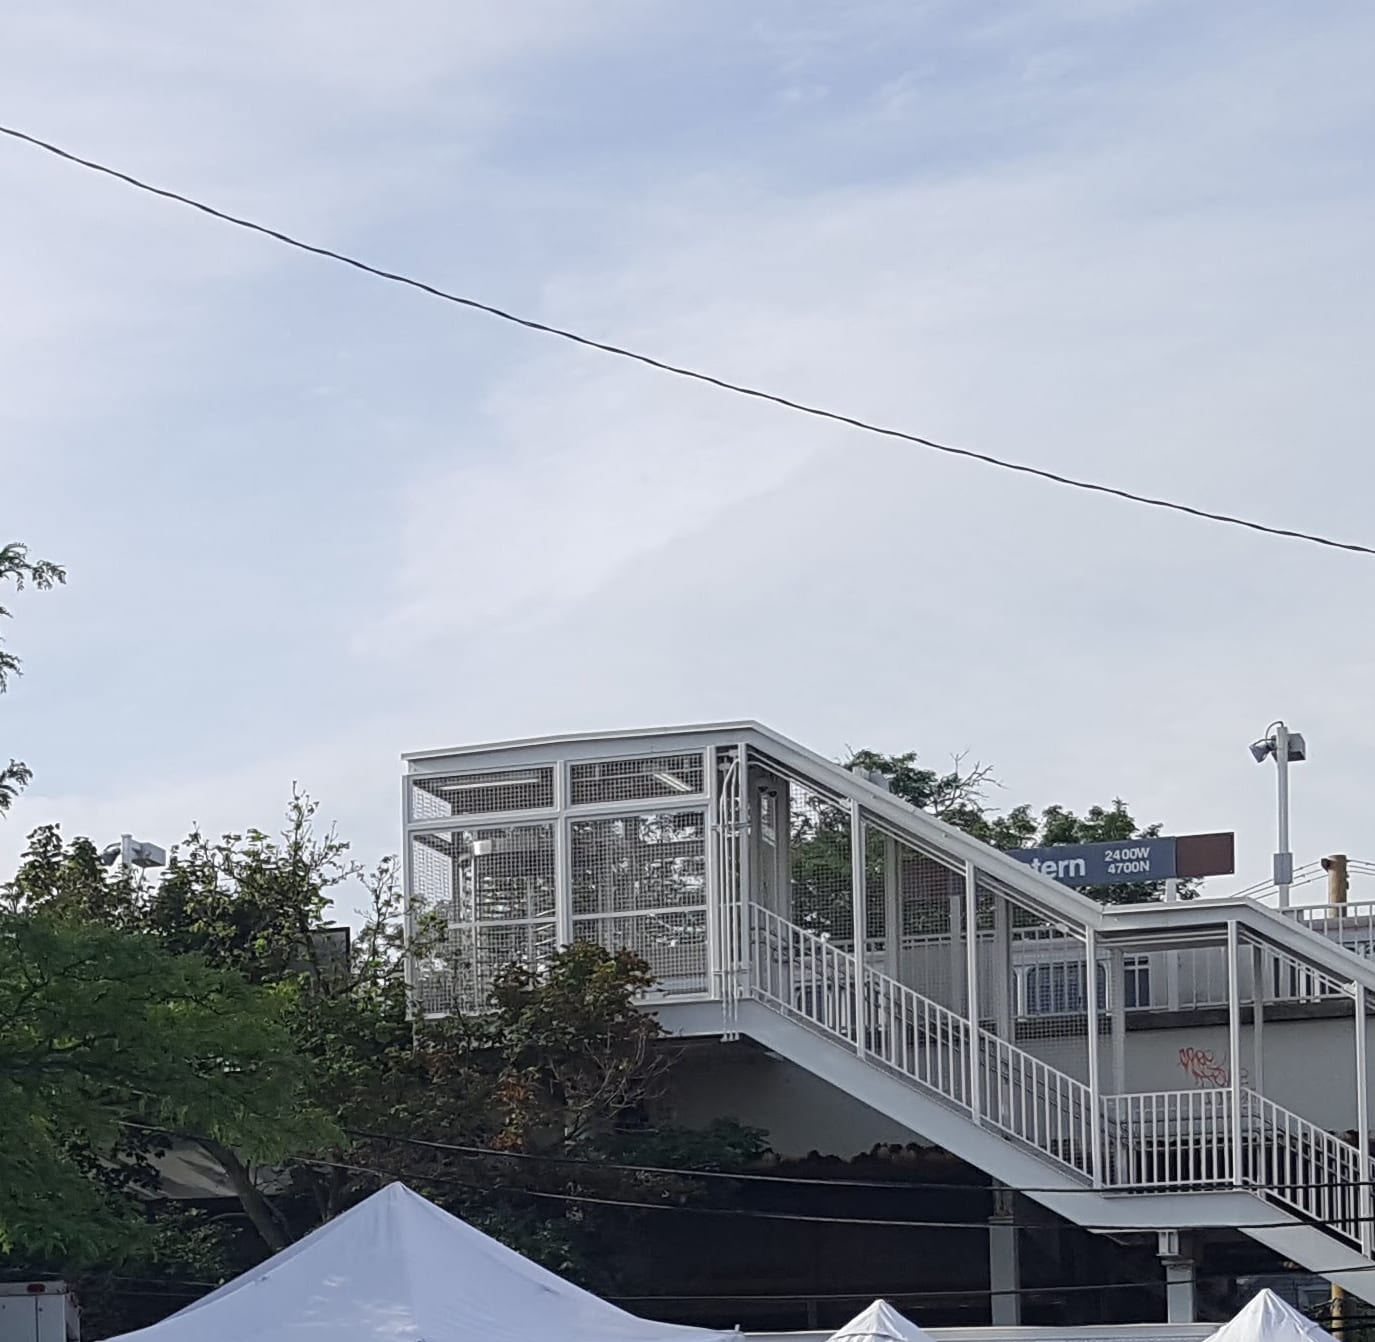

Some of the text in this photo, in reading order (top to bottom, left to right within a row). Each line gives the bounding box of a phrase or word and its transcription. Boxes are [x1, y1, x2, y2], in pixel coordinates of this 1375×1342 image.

[1104, 847, 1150, 861] 2400W
[1031, 858, 1086, 878] tern
[1107, 860, 1150, 874] 4700N
